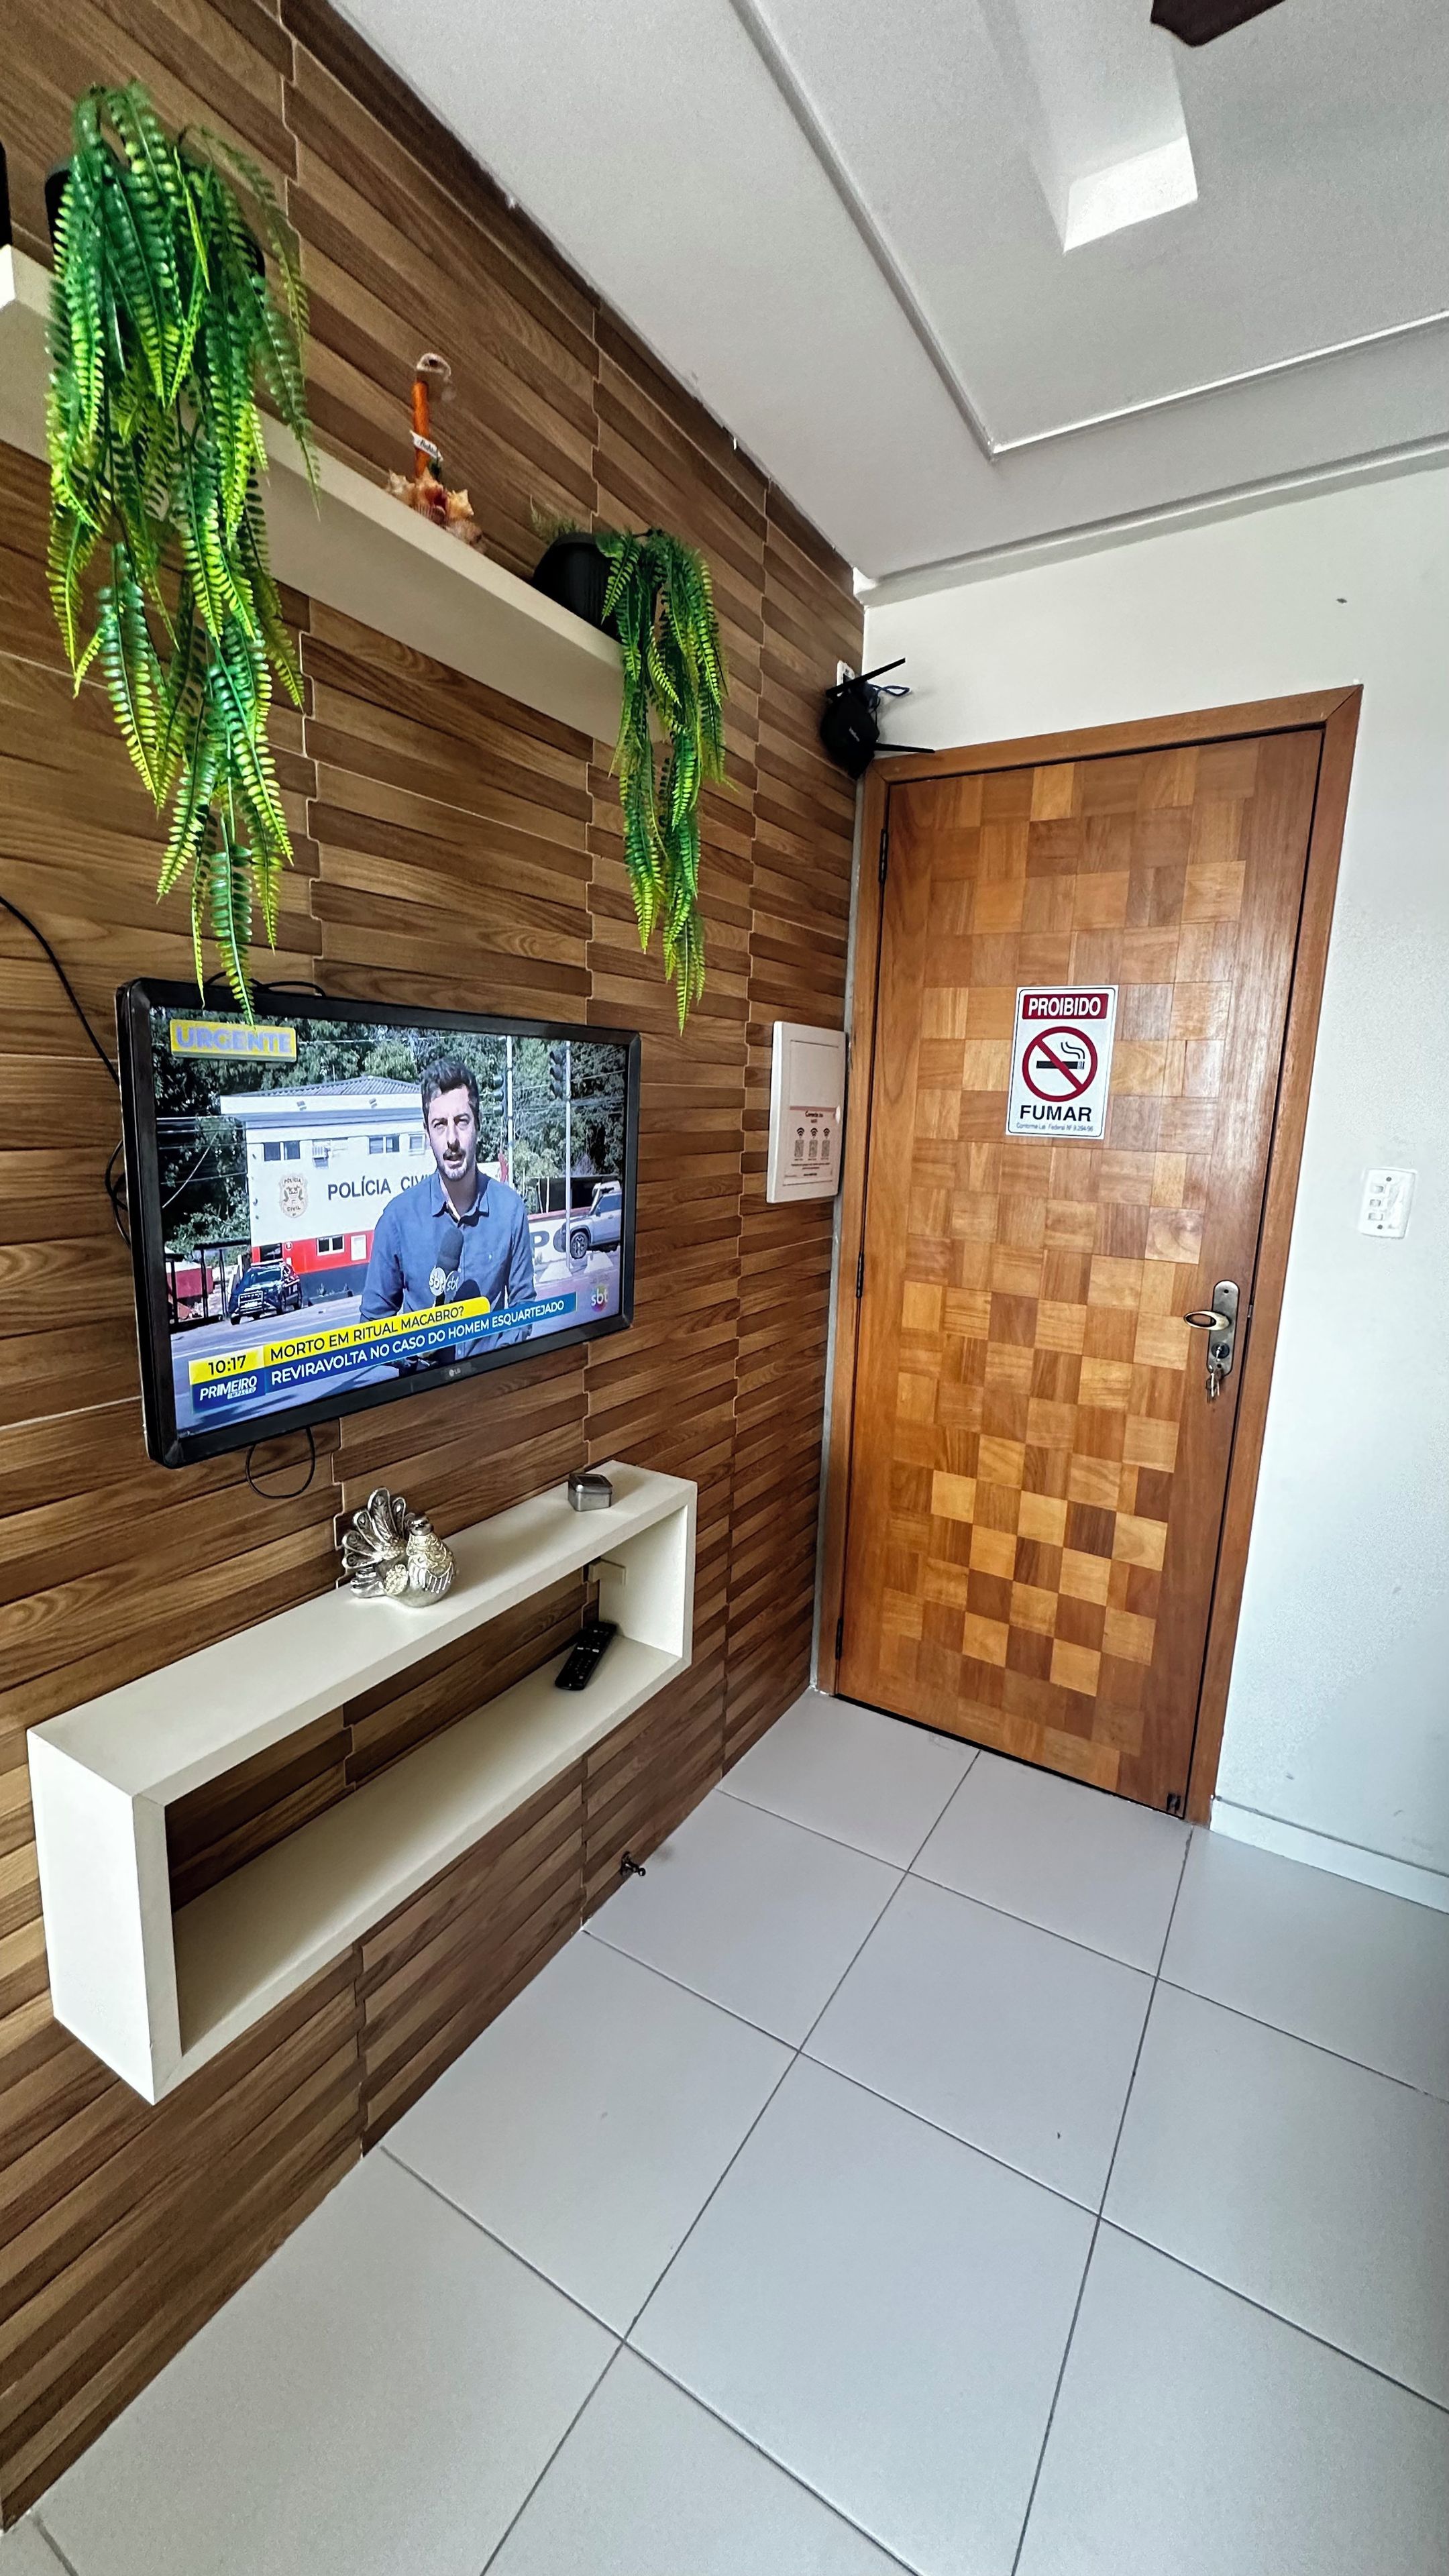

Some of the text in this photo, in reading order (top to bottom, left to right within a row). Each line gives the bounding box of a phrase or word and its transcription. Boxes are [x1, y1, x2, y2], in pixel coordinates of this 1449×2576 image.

[1028, 996, 1102, 1016] PROIBIDO
[175, 1024, 292, 1053] URGENTE
[1020, 1104, 1092, 1122] FUMAR
[327, 1174, 428, 1200] POLÍCIA CIV
[590, 1287, 608, 1306] sbt
[270, 1305, 464, 1361] MORTO EM RITUAL MACABRO?
[271, 1300, 565, 1385] REVIRAVOLTA NO CASO DO HOMEM ESQUARTEJADO
[208, 1355, 246, 1375] 10:17
[200, 1375, 258, 1401] PRIMEIRO
